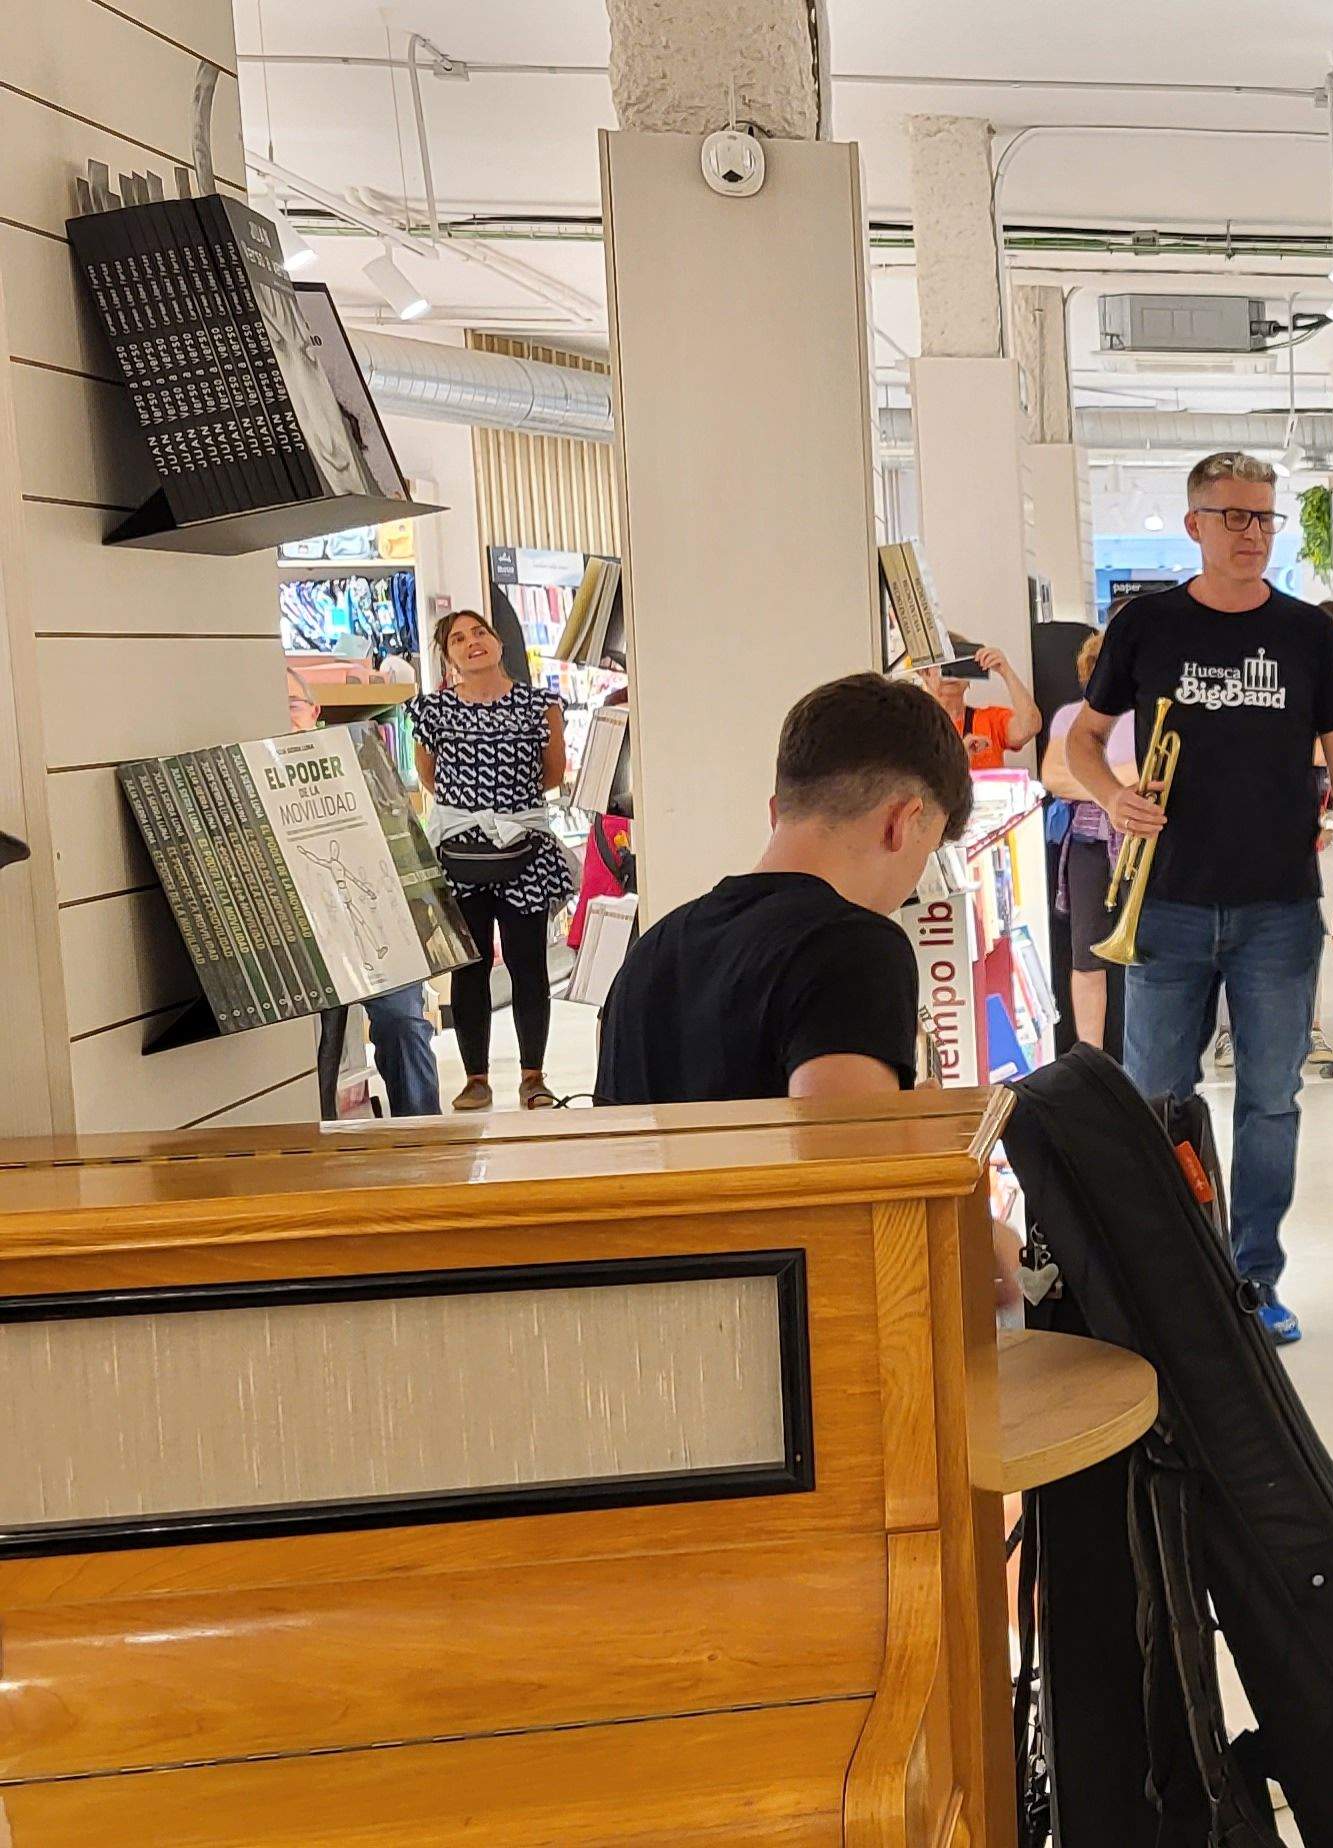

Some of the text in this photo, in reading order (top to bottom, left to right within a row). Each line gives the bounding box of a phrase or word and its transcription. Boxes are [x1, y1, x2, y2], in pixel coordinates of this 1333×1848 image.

[188, 429, 207, 468] JUAN
[201, 426, 220, 464] JUAN
[214, 424, 233, 462] JUAN
[228, 421, 247, 460] JUAN
[242, 418, 262, 456] JUAN
[256, 416, 275, 454] JUAN
[272, 414, 291, 452] JUAN
[284, 412, 304, 450] JUAN
[149, 436, 168, 475] JUAN
[161, 434, 180, 473] JUAN
[174, 432, 194, 471] JUAN
[1113, 582, 1141, 593] paper
[1183, 662, 1241, 679] Huesca
[264, 756, 345, 790] EL PODER
[299, 786, 320, 798] DE LA
[279, 792, 357, 826] MOVILIDAD
[918, 901, 953, 947] lib
